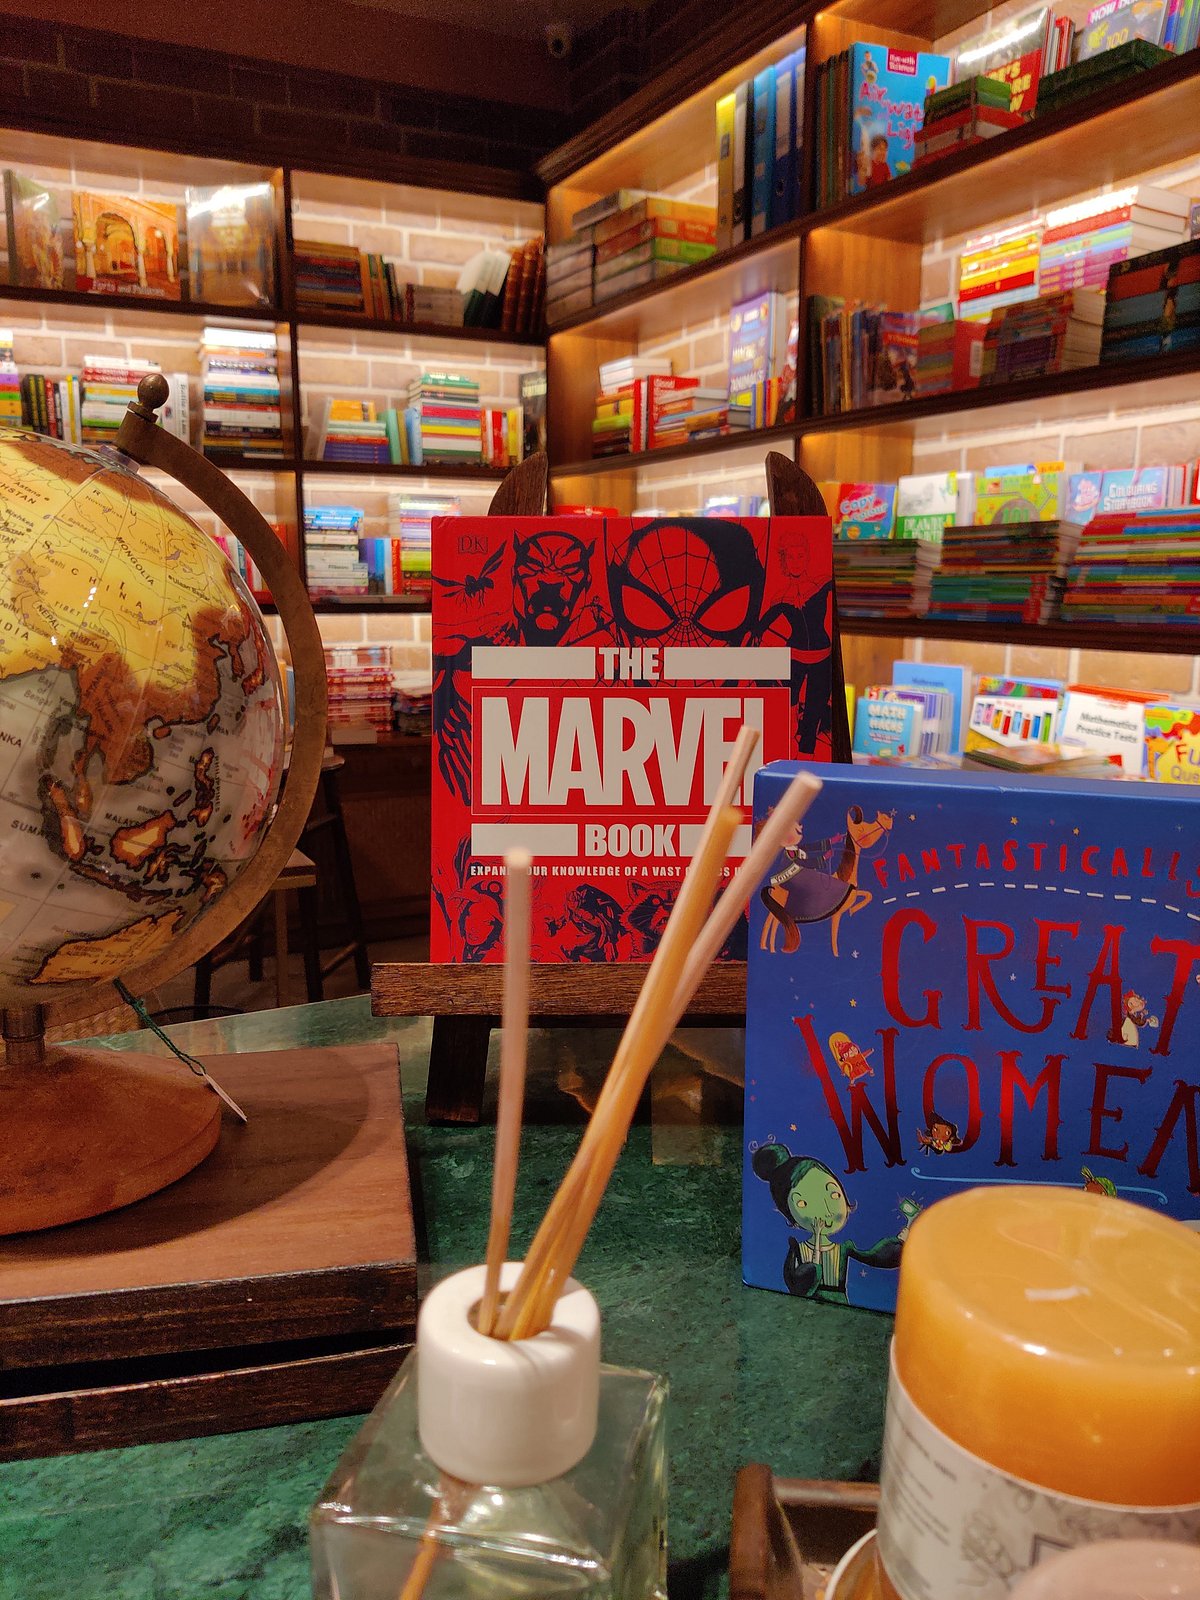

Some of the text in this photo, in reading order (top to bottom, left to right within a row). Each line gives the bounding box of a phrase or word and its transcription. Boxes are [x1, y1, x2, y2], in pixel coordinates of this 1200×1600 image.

[14, 482, 41, 497] Astana
[1109, 482, 1158, 498] COLOURING
[1103, 496, 1154, 512] STORYBOOK
[1003, 508, 1030, 523] 101
[461, 535, 486, 553] DK
[45, 555, 65, 569] Kashi
[116, 537, 155, 586] MONGOLIA
[37, 604, 60, 631] NEPAL
[55, 601, 81, 617] TIBET
[3, 622, 29, 640] DIA
[599, 647, 660, 681] THE
[1081, 712, 1138, 731] Mathematics
[1076, 723, 1138, 744] Practice Tests
[481, 697, 764, 807] MARVEL
[585, 823, 677, 857] BOOK
[527, 866, 548, 877] OUR
[552, 866, 621, 877] KNOWLEDGE
[624, 866, 638, 877] OF
[641, 866, 649, 877] A
[652, 866, 681, 877] VAST
[881, 908, 1200, 1056] GREAT
